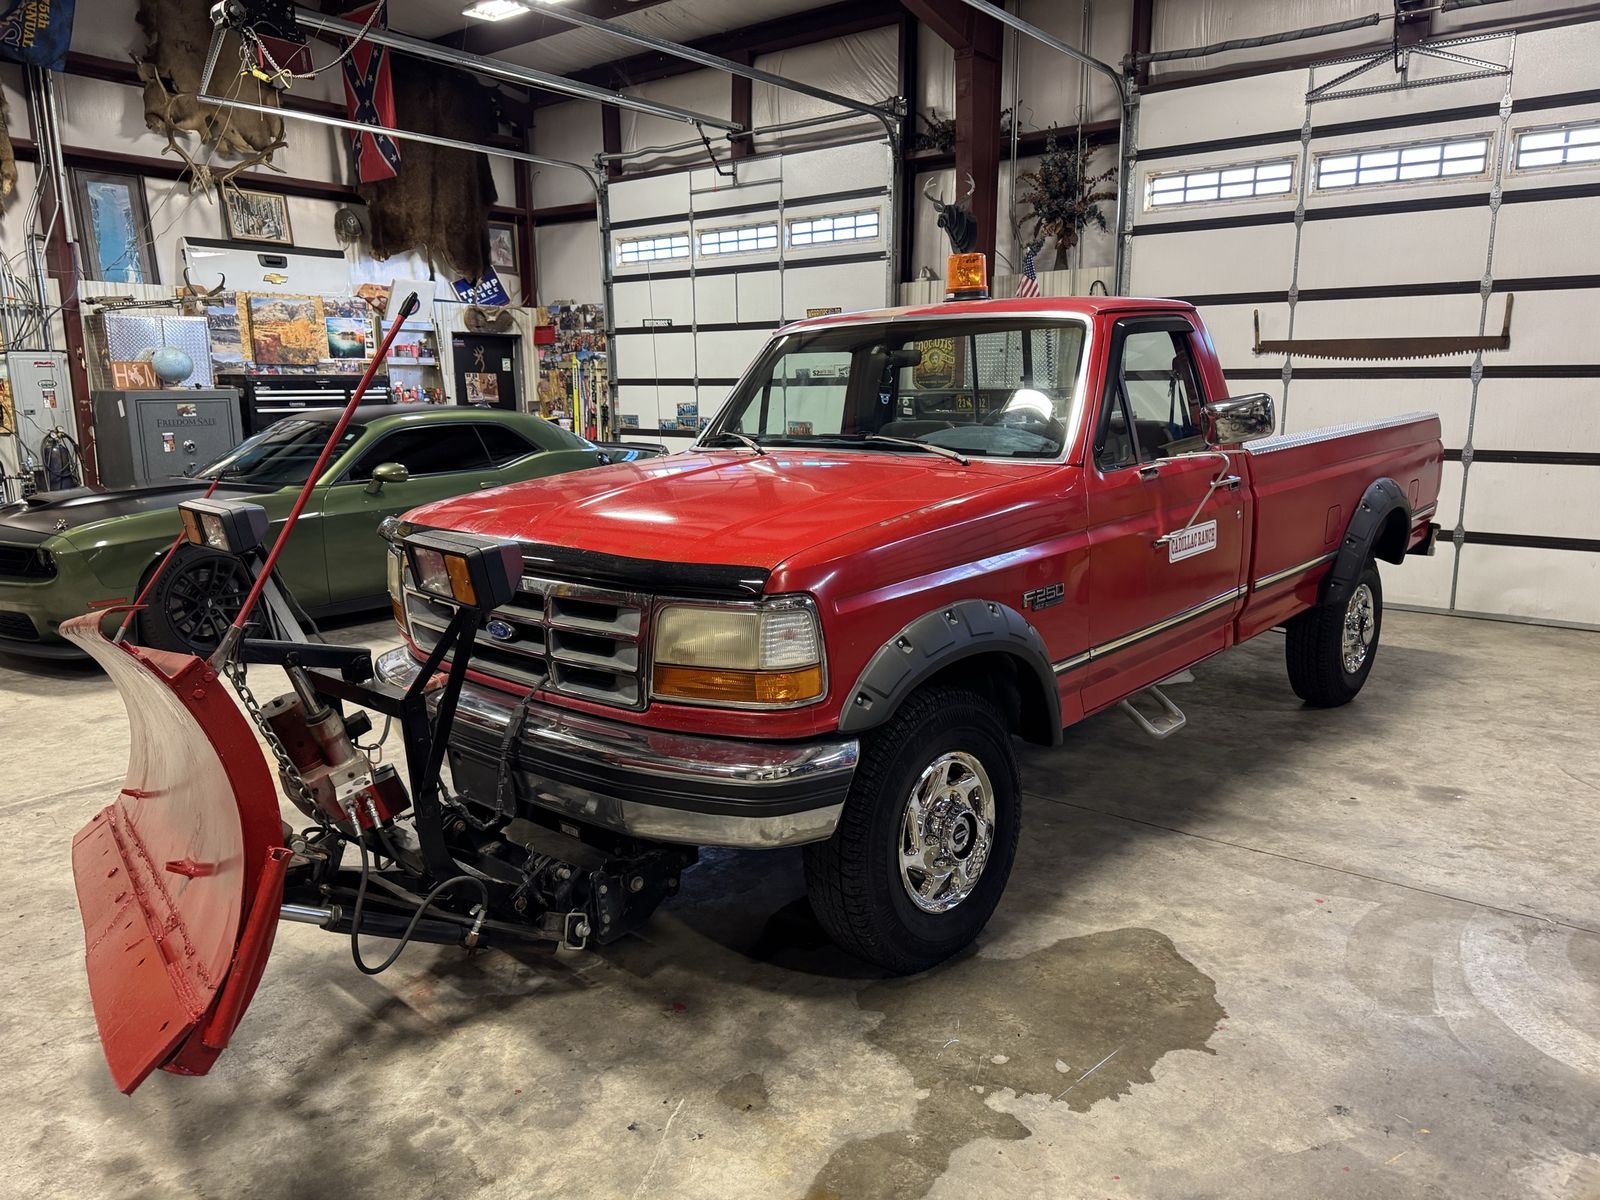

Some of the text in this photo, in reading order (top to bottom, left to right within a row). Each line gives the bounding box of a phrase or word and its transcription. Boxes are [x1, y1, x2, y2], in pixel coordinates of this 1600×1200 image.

[22, 1, 37, 48] NNUAL
[460, 278, 498, 300] TRUMP
[157, 418, 196, 428] FREEDOM
[1171, 527, 1215, 555] CADILLAC RANCH
